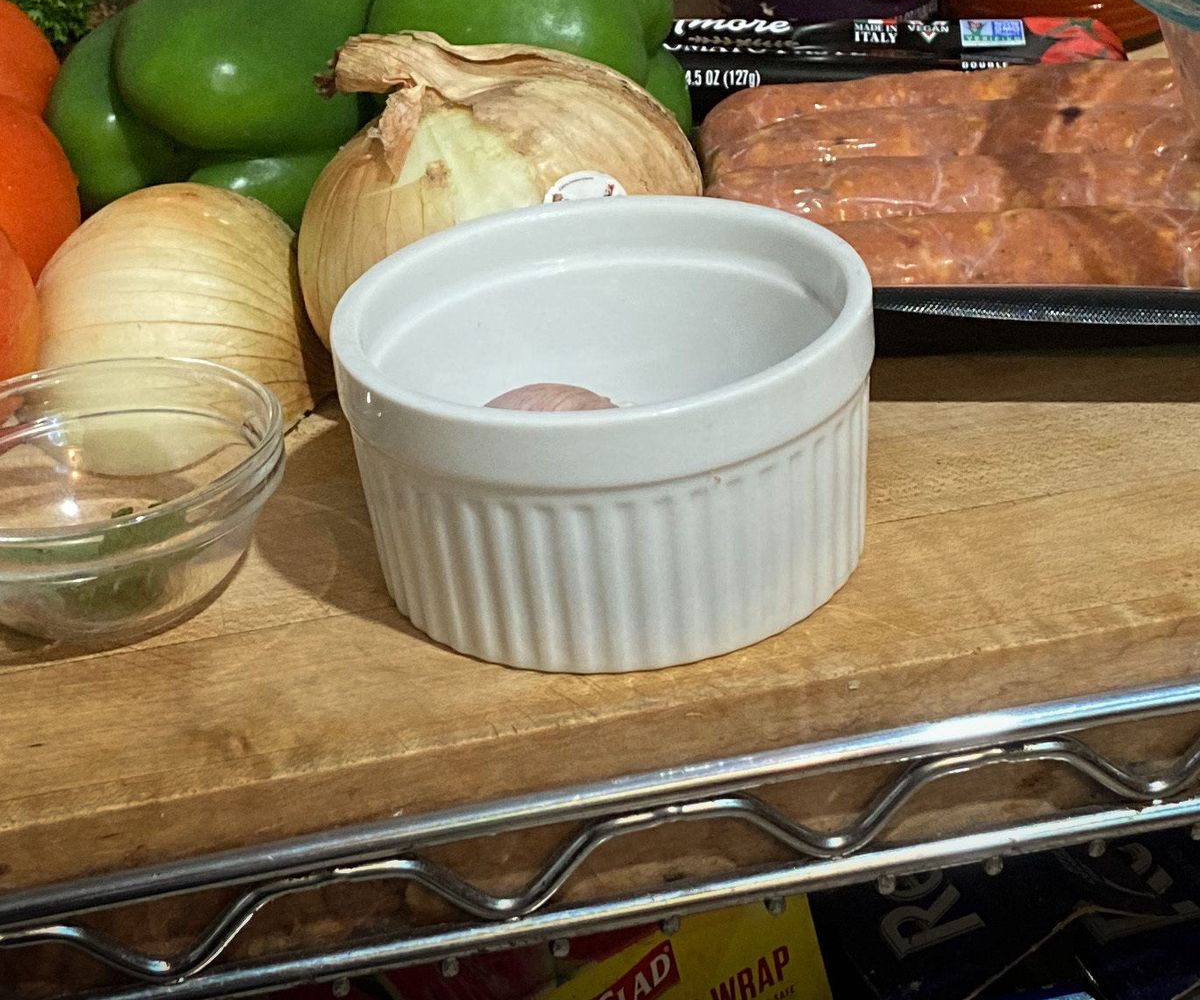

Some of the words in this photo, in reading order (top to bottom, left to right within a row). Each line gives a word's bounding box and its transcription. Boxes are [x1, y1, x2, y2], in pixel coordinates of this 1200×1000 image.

[854, 22, 882, 32] MADE
[885, 23, 898, 33] IN
[907, 22, 949, 34] VEGAN
[854, 31, 898, 44] ITALY
[705, 70, 720, 86] OZ
[723, 70, 761, 88] (127g)
[598, 953, 672, 1000] AD
[710, 945, 790, 1000] WRAP
